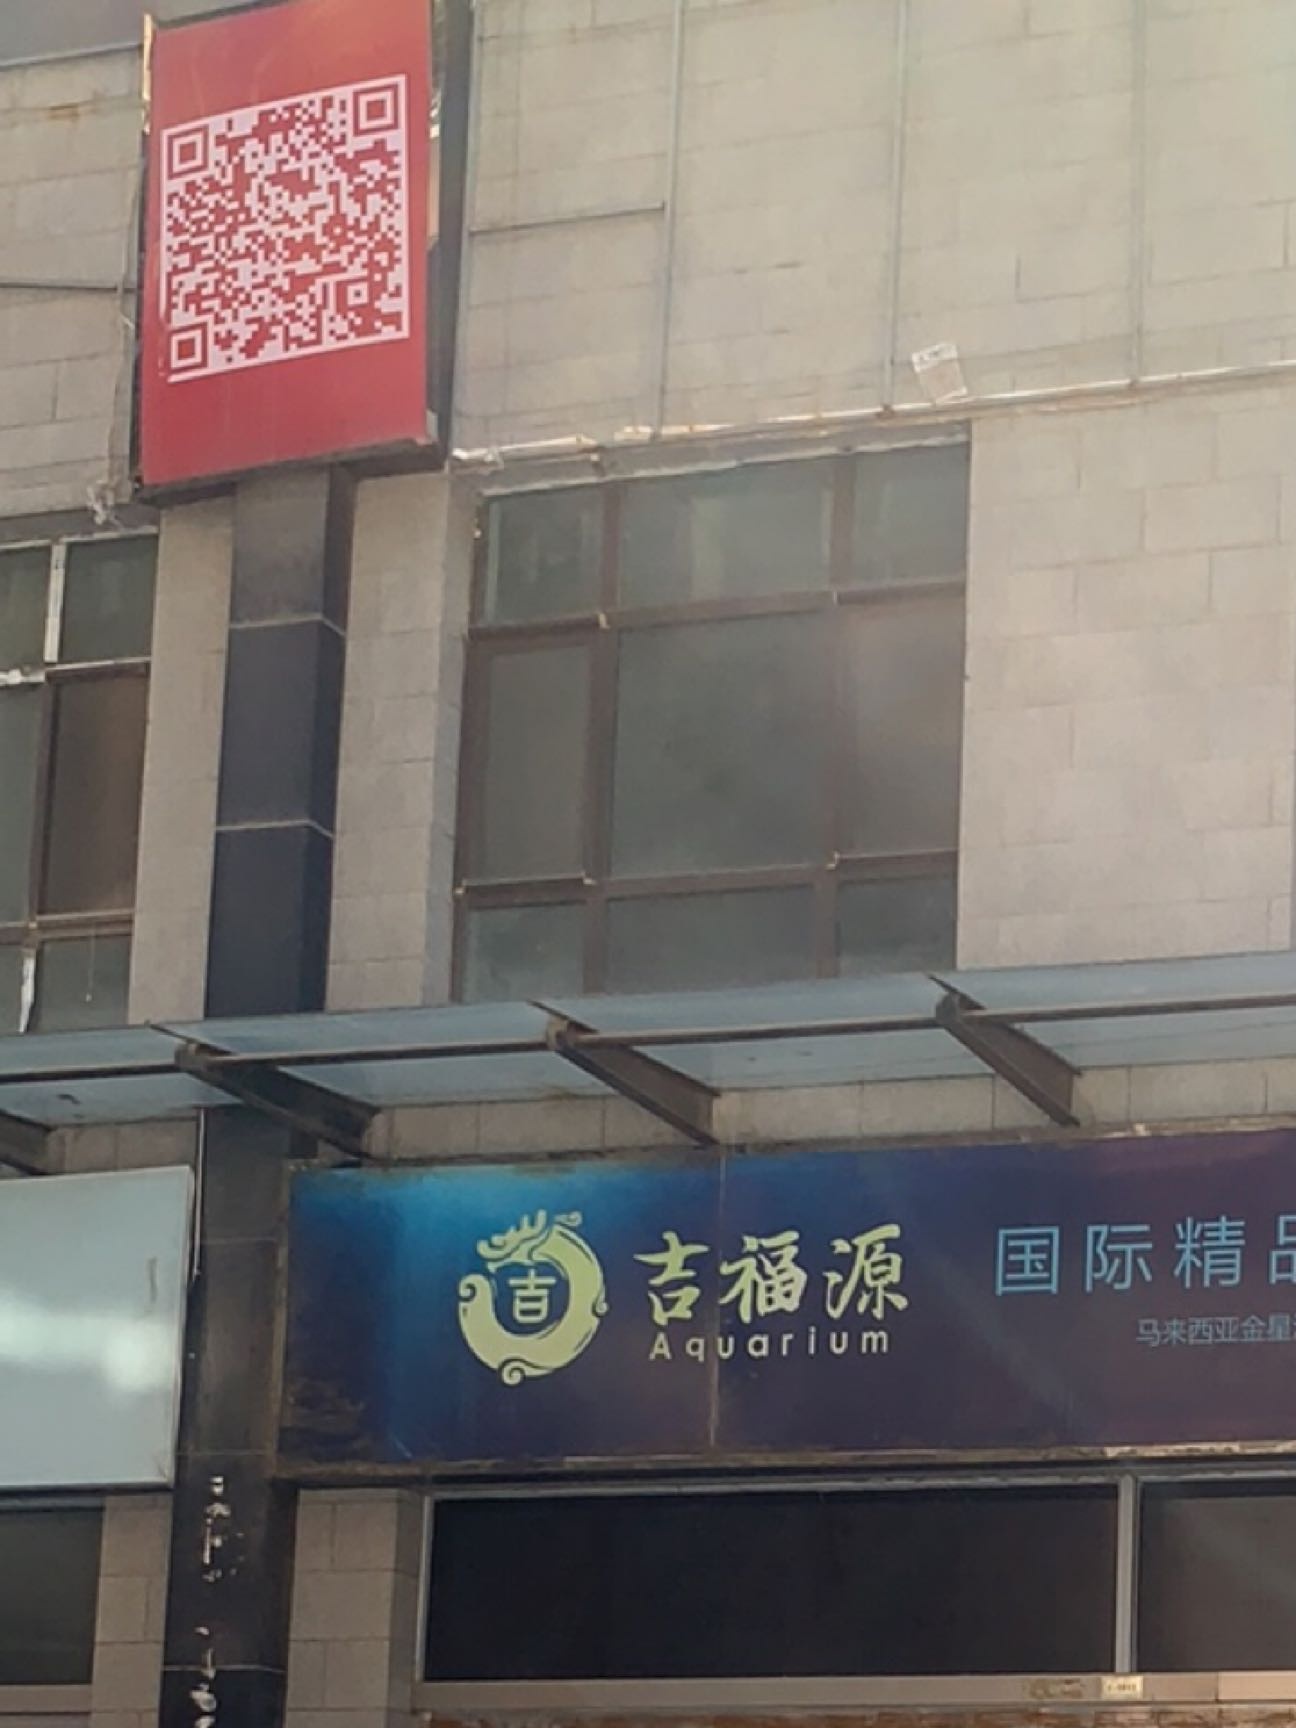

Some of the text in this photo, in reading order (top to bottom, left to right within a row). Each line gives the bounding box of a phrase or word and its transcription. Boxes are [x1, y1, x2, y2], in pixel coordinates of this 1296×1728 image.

[633, 1224, 908, 1325] 吉福源
[649, 1326, 890, 1362] Aquarium
